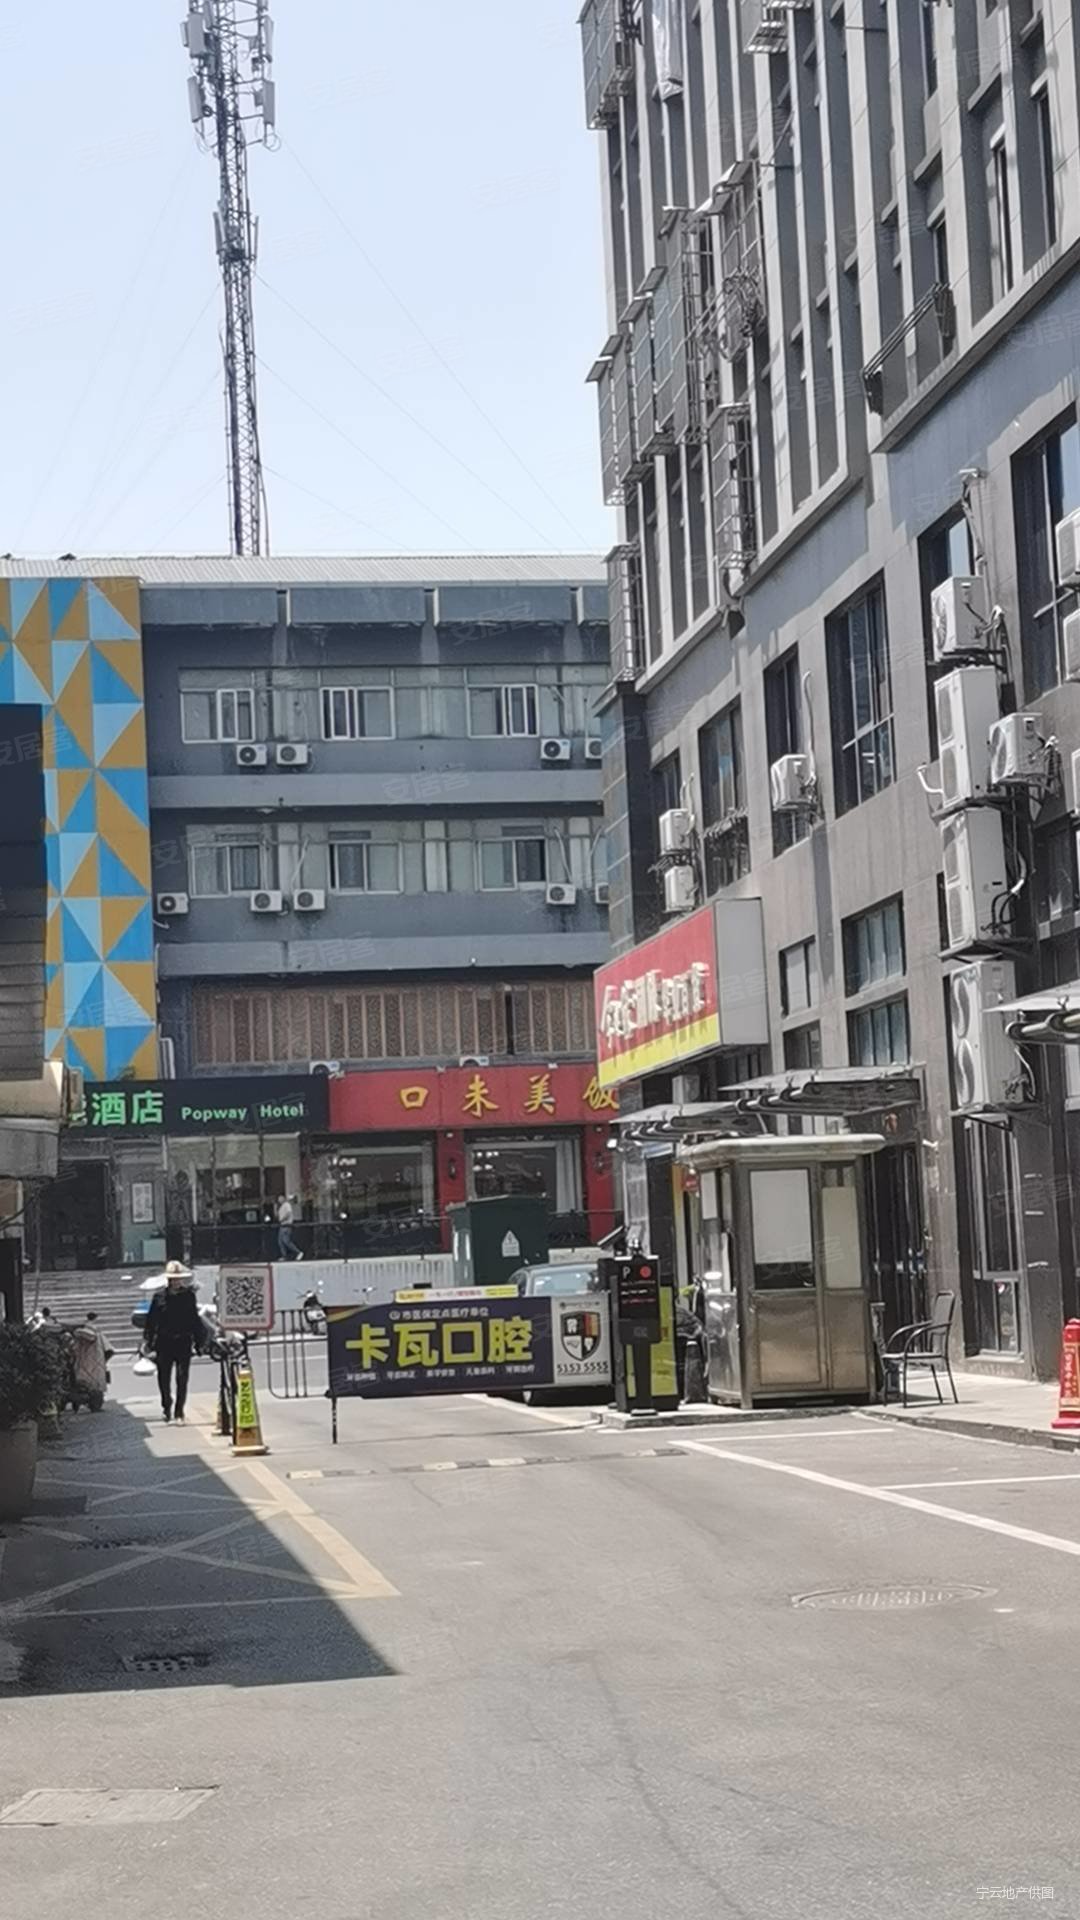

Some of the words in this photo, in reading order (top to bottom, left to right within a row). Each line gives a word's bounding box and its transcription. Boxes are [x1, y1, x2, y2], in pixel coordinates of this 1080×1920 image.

[181, 1106, 248, 1122] Popway
[260, 1103, 304, 1118] Hotel
[345, 1315, 533, 1370] 卡瓦口腔
